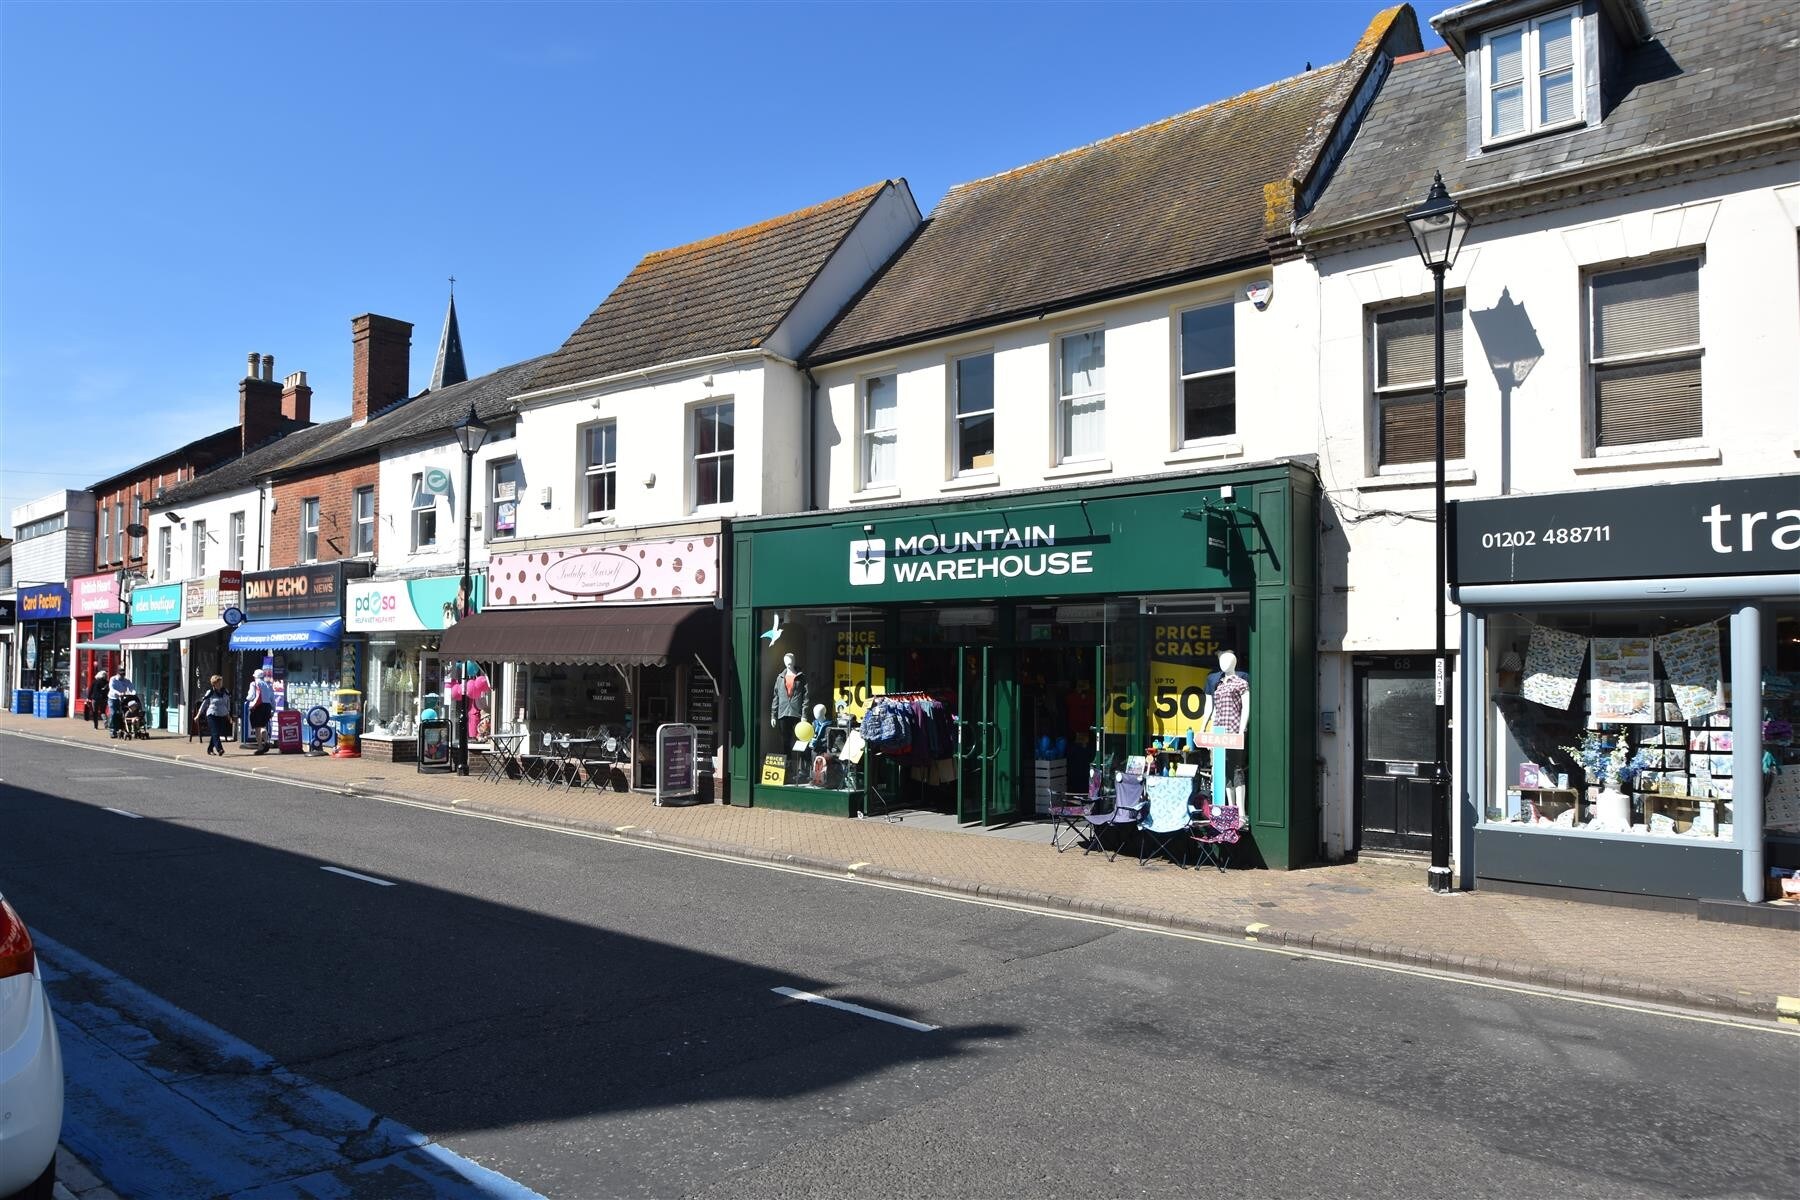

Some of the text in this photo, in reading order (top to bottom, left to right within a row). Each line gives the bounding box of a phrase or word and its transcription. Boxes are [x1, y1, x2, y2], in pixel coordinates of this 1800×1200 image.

[894, 524, 1055, 556] MOUNTAIN
[1482, 525, 1610, 549] 01202 488711
[893, 550, 1093, 583] WAREHOUSE
[245, 580, 274, 600] DAILY
[276, 575, 308, 597] ECHO
[313, 583, 333, 594] NEWS
[24, 593, 62, 612] Card Factory
[97, 618, 121, 629] eden
[838, 631, 876, 643] PRICE
[1155, 625, 1211, 640] PRICE
[1155, 641, 1219, 656] CRASH
[1394, 659, 1410, 670] 68
[1155, 677, 1175, 685] UP TO
[1153, 685, 1207, 721] 50
[1201, 734, 1237, 746] BEACH
[764, 771, 779, 781] 50
